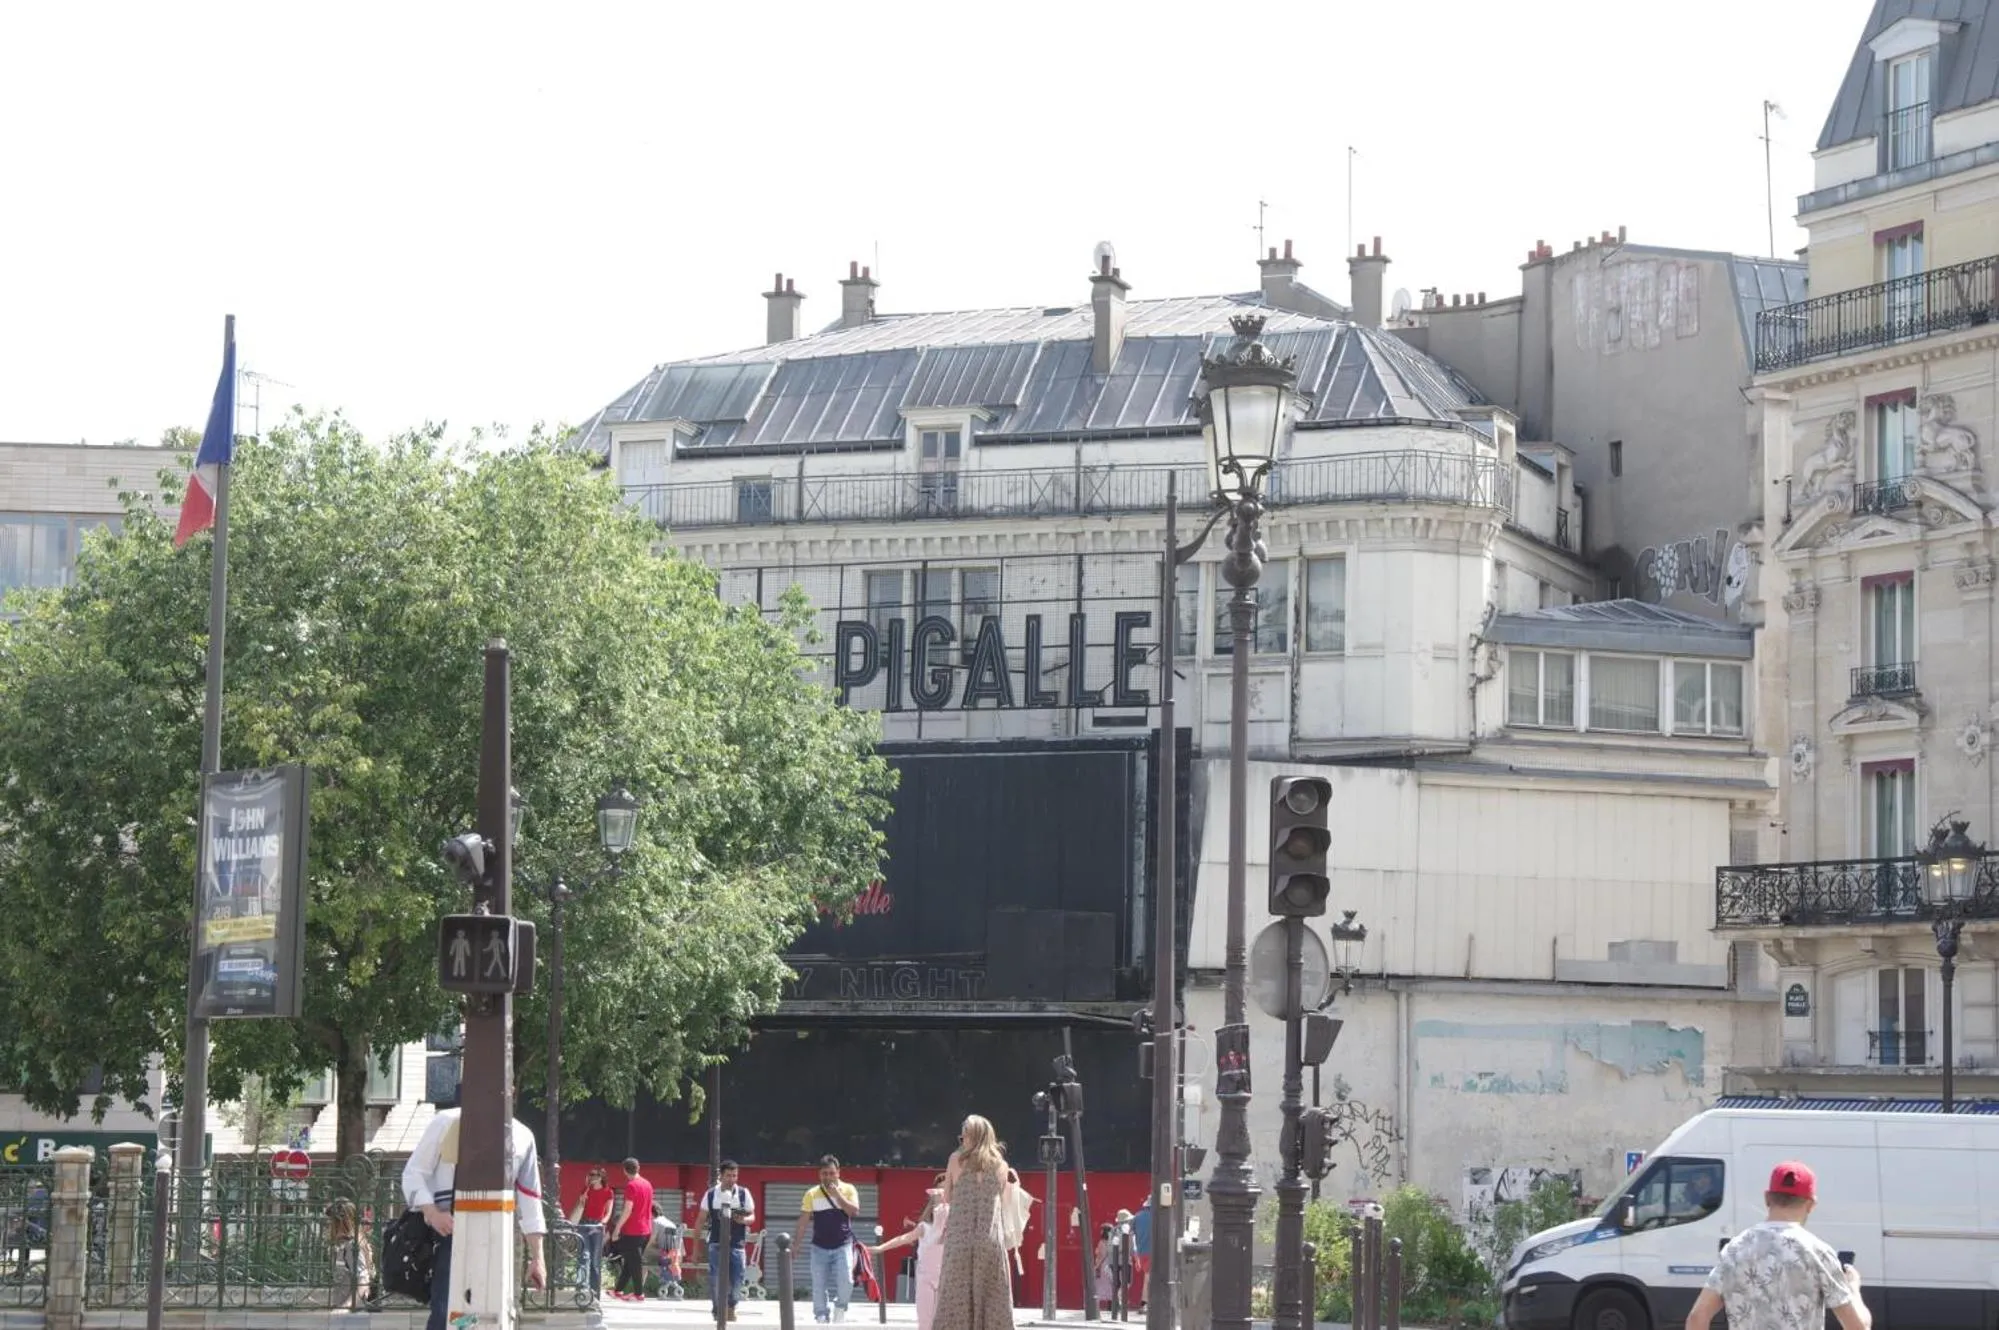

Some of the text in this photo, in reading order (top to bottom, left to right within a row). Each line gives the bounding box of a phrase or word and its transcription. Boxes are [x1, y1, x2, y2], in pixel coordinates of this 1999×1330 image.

[835, 611, 1152, 711] PIGALLE
[228, 807, 266, 832] JOHN
[213, 834, 280, 863] WILLIAMS
[840, 966, 985, 999] NIGHT
